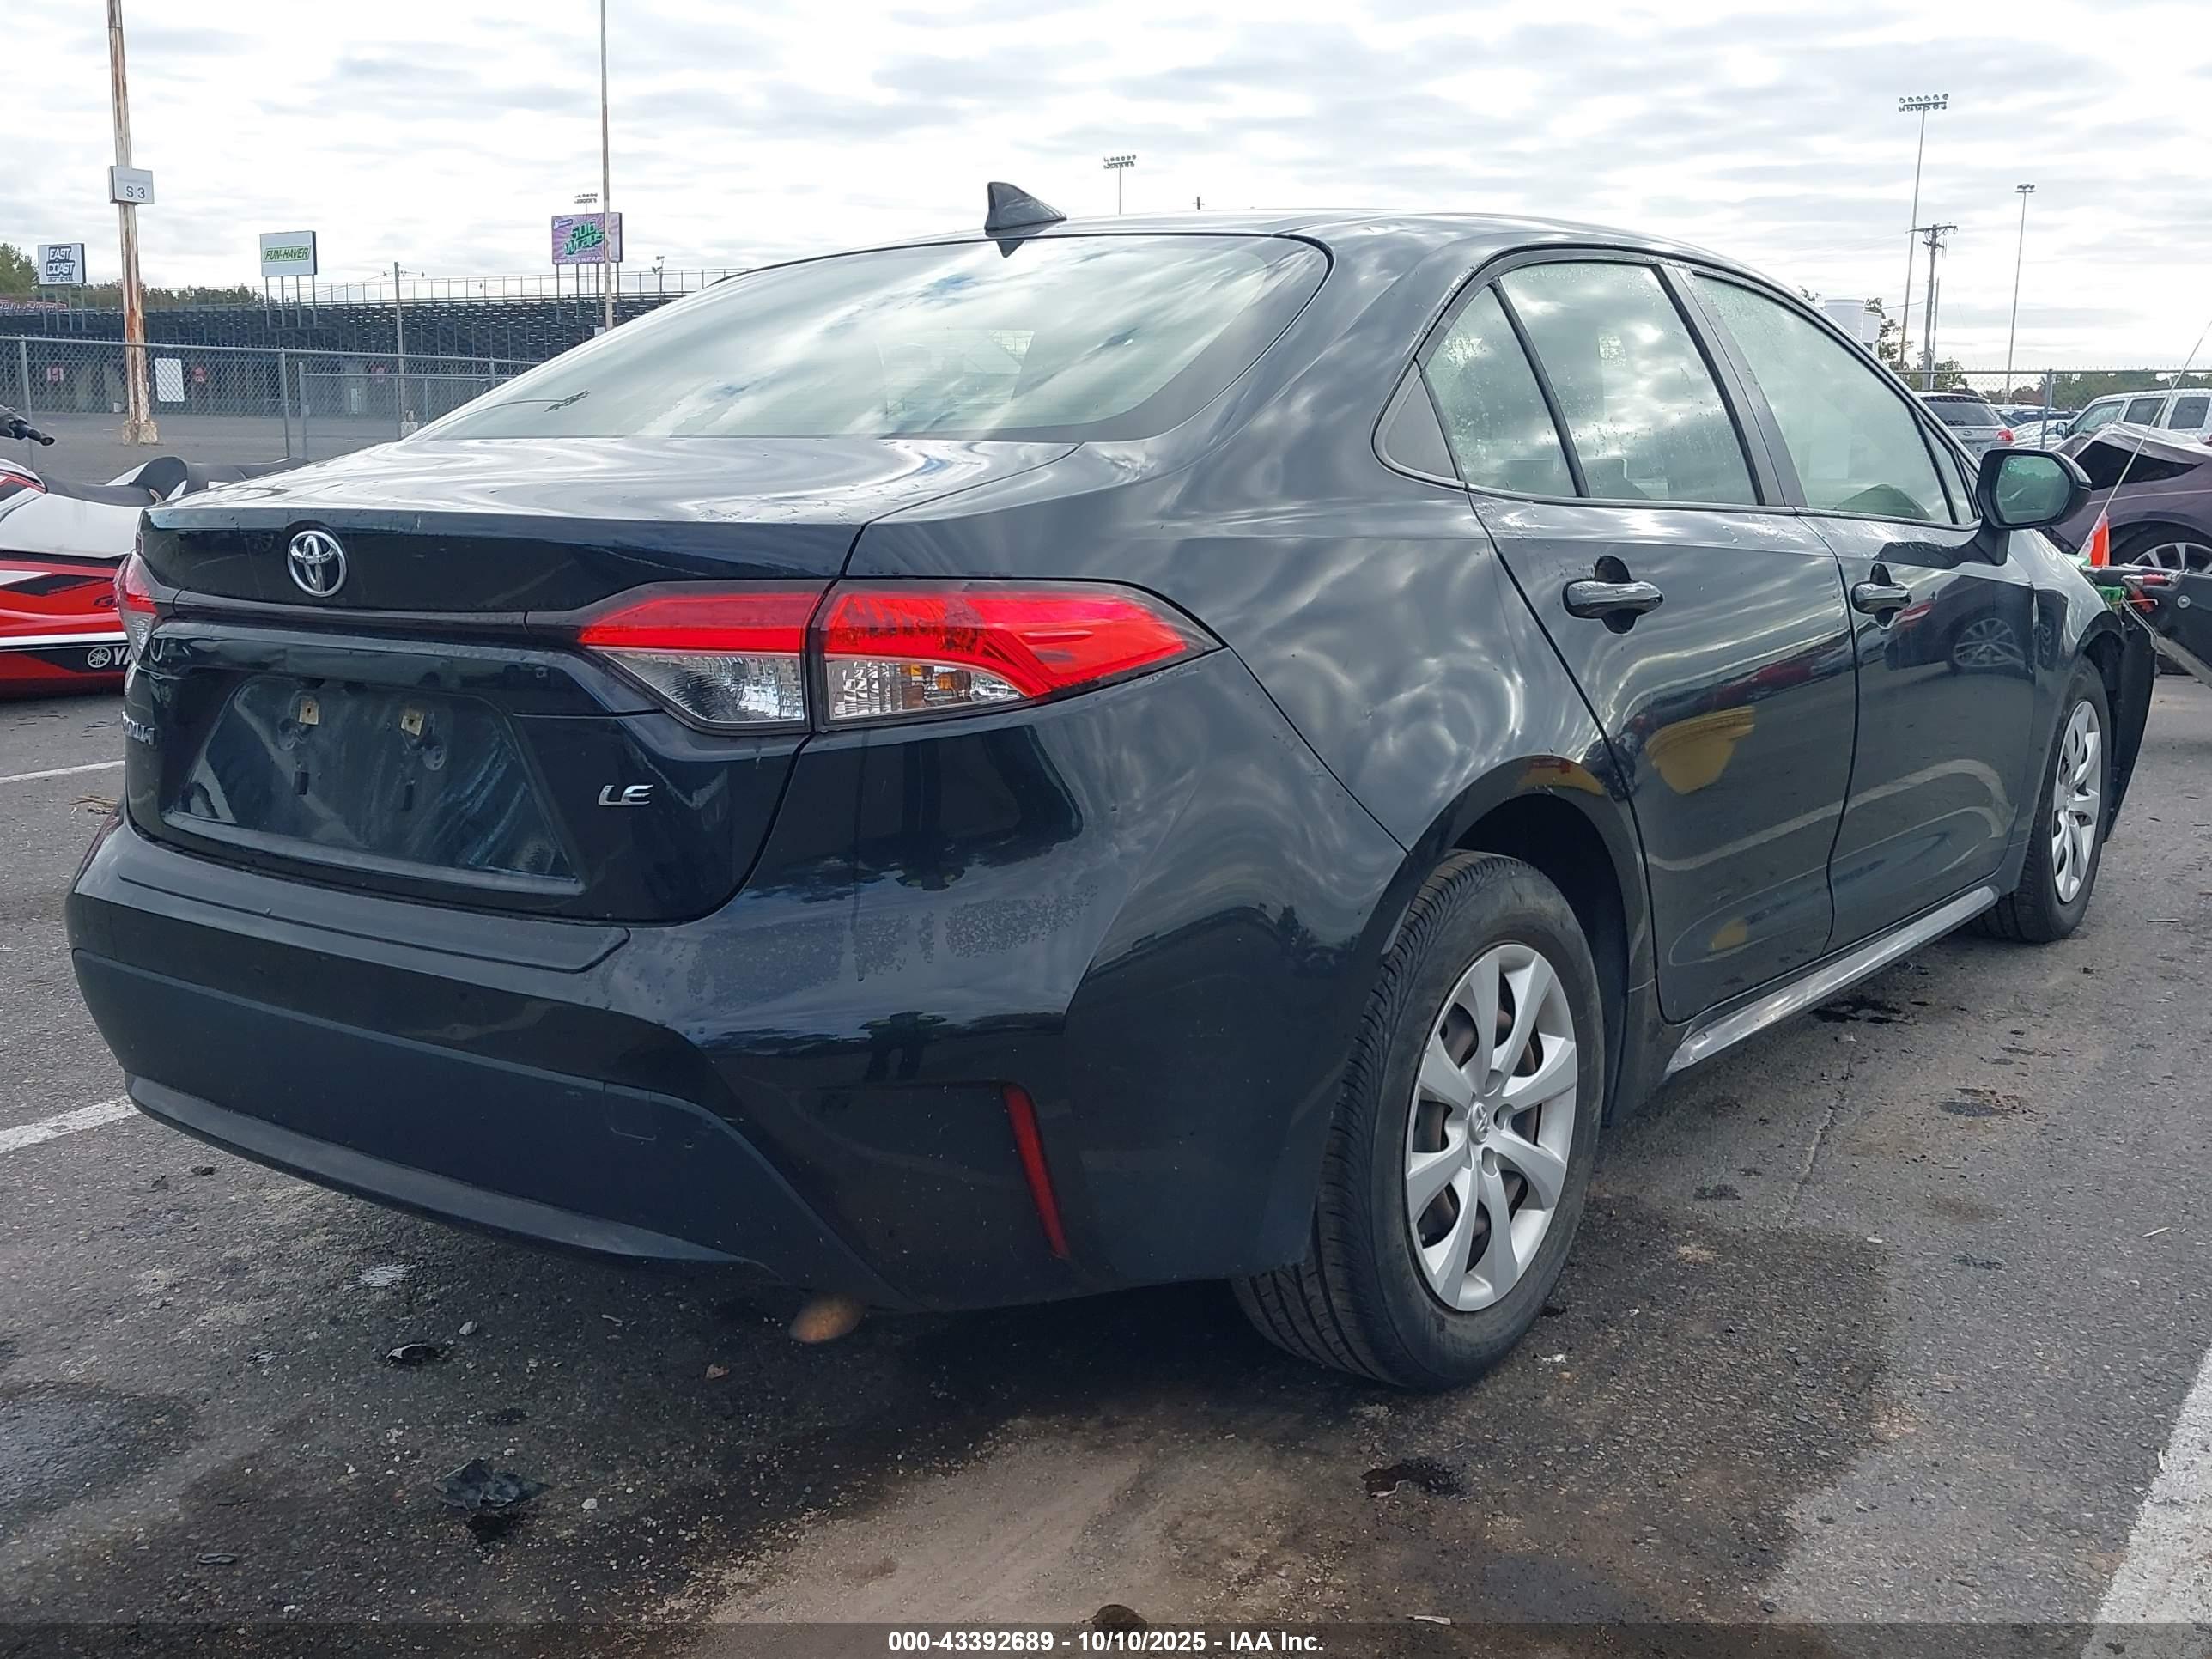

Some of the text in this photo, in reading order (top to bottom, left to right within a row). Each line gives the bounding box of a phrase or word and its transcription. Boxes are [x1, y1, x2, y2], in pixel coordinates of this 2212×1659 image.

[125, 185, 146, 199] S 3
[571, 221, 597, 240] 506
[49, 247, 71, 261] EAST
[264, 246, 310, 261] FUN-HAVER
[46, 261, 76, 275] COAST
[598, 784, 653, 806] LE
